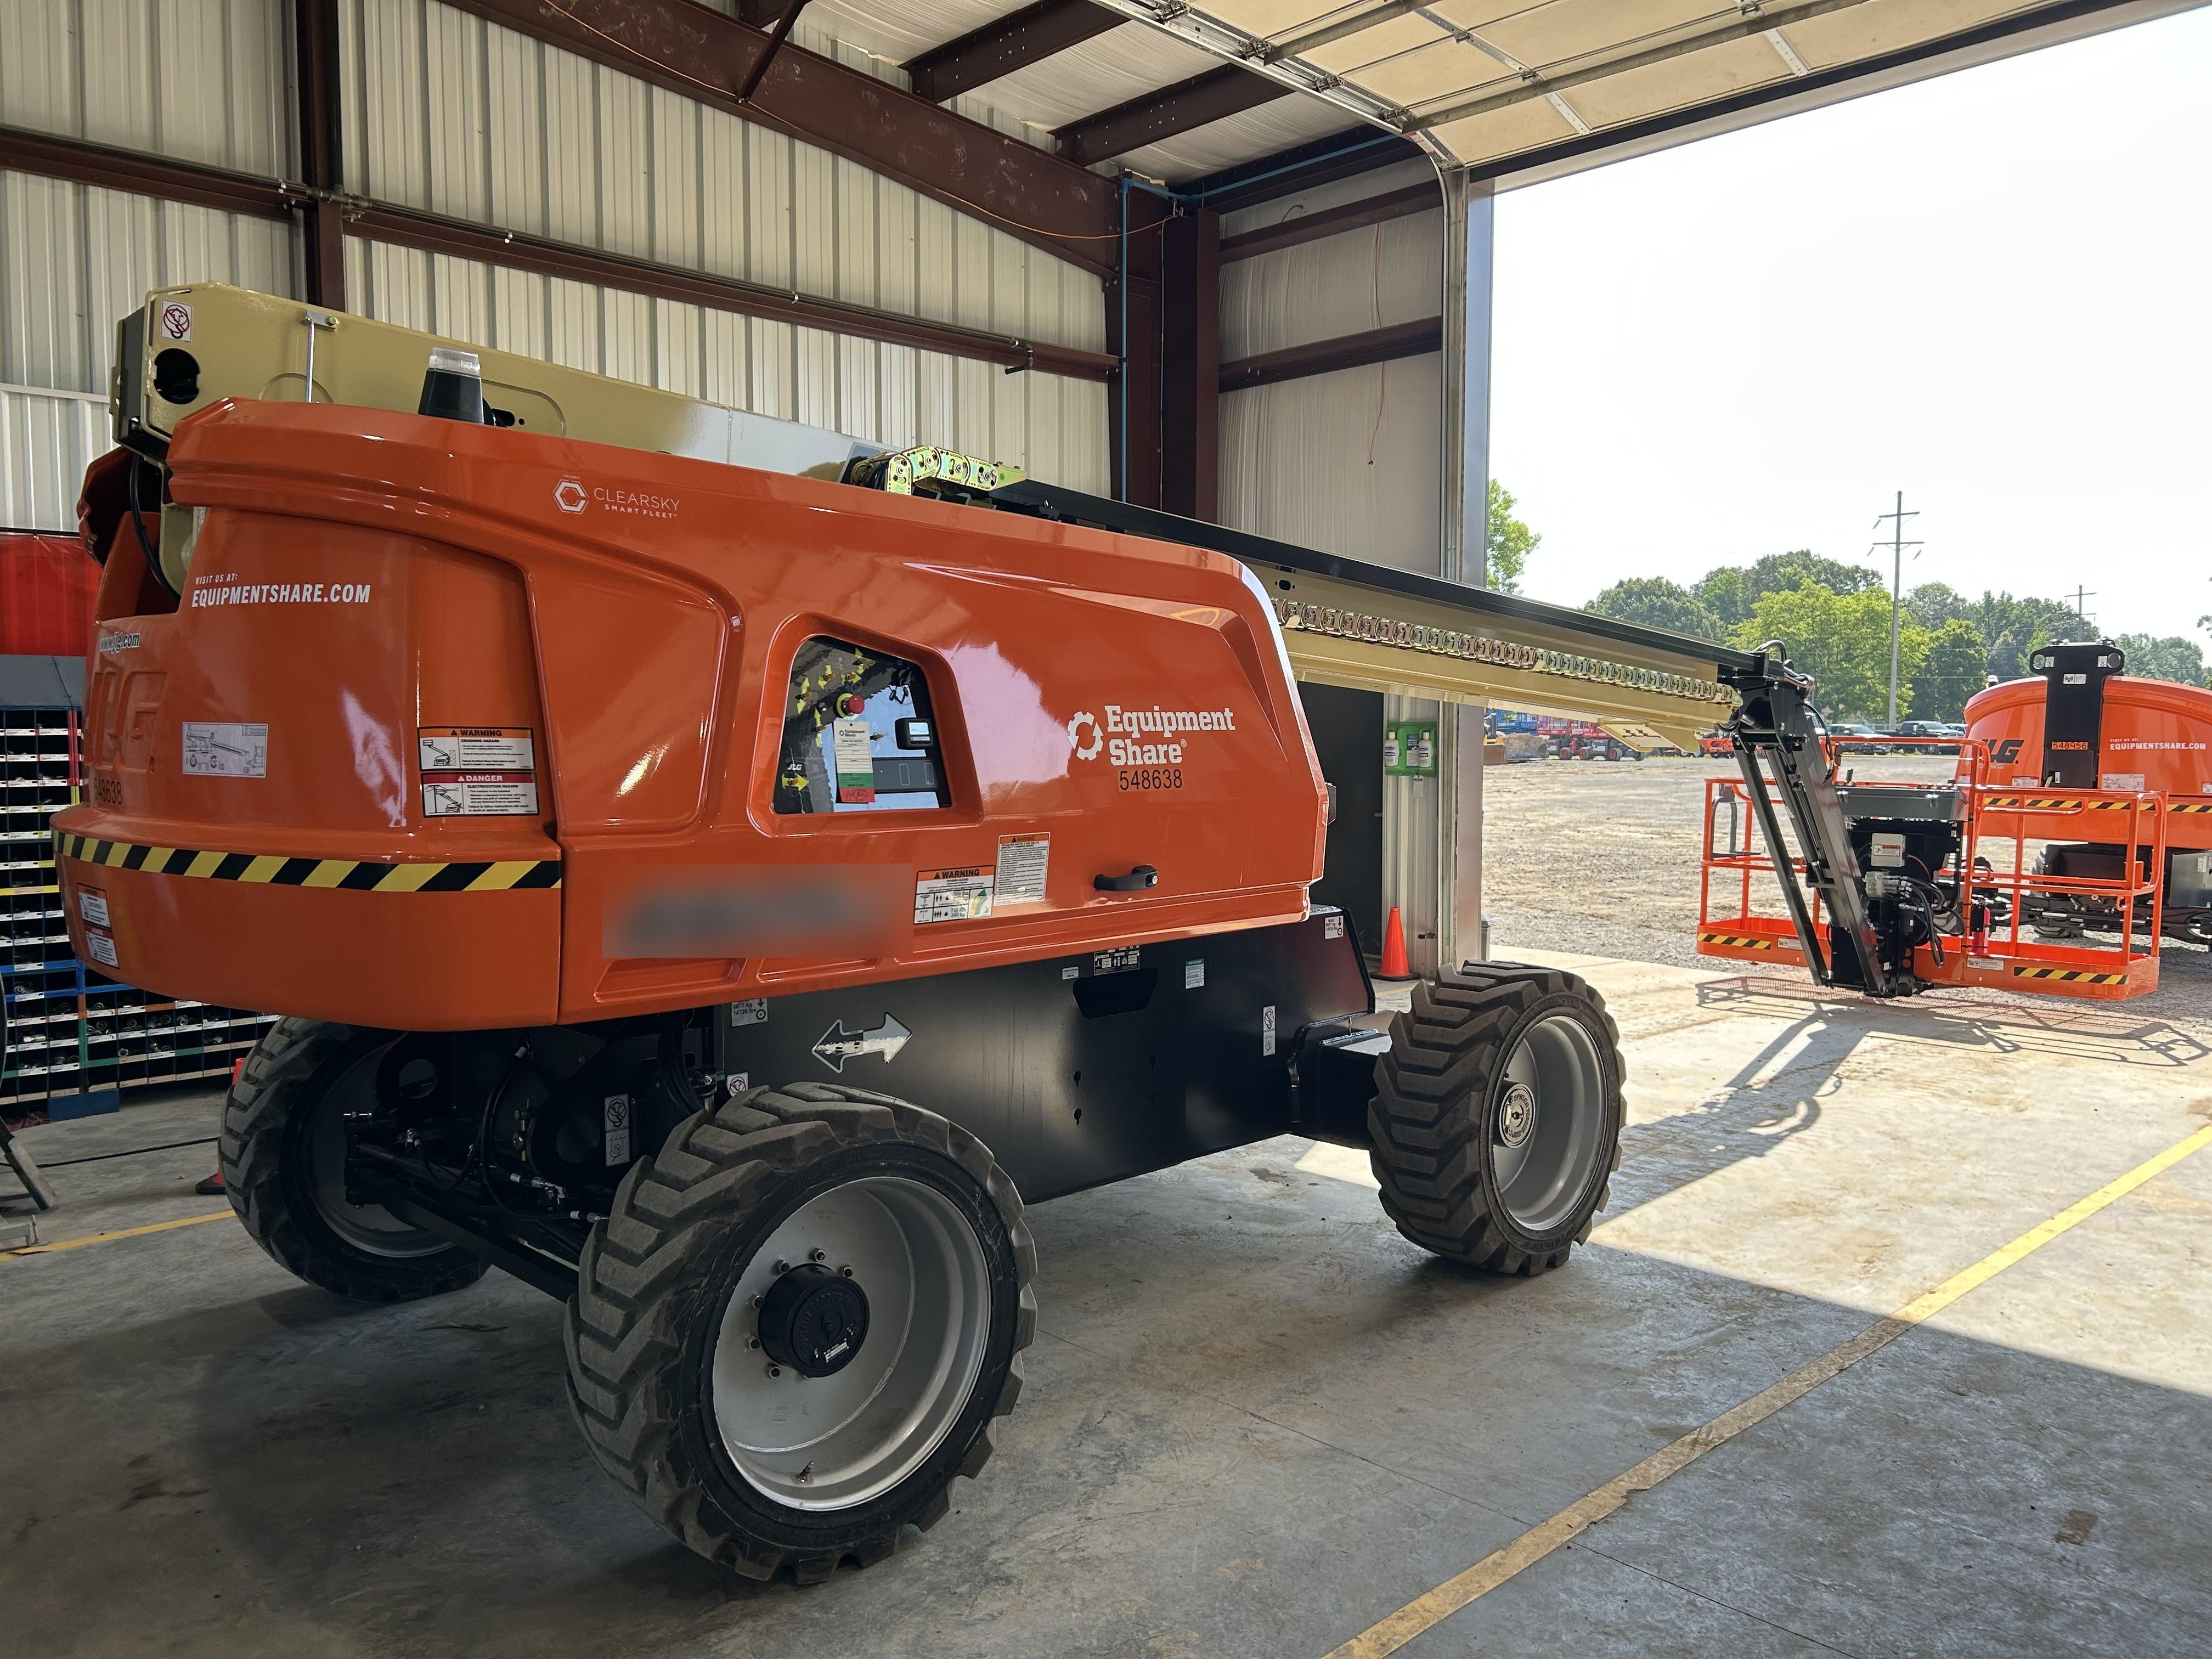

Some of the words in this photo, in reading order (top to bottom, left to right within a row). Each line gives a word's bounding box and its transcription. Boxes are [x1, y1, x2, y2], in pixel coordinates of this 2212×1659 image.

[594, 487, 680, 511] CLEARSKY
[605, 504, 639, 514] SMART
[196, 575, 212, 585] VISIT
[216, 574, 224, 583] US
[226, 573, 238, 582] AT:
[192, 584, 371, 608] EQUIPMENTSHARE.COM
[1104, 705, 1236, 738] Equipment
[2110, 742, 2206, 751] EQUIPMENTSHARE.COM
[1119, 769, 1182, 791] 548638
[942, 868, 980, 878] WARNING
